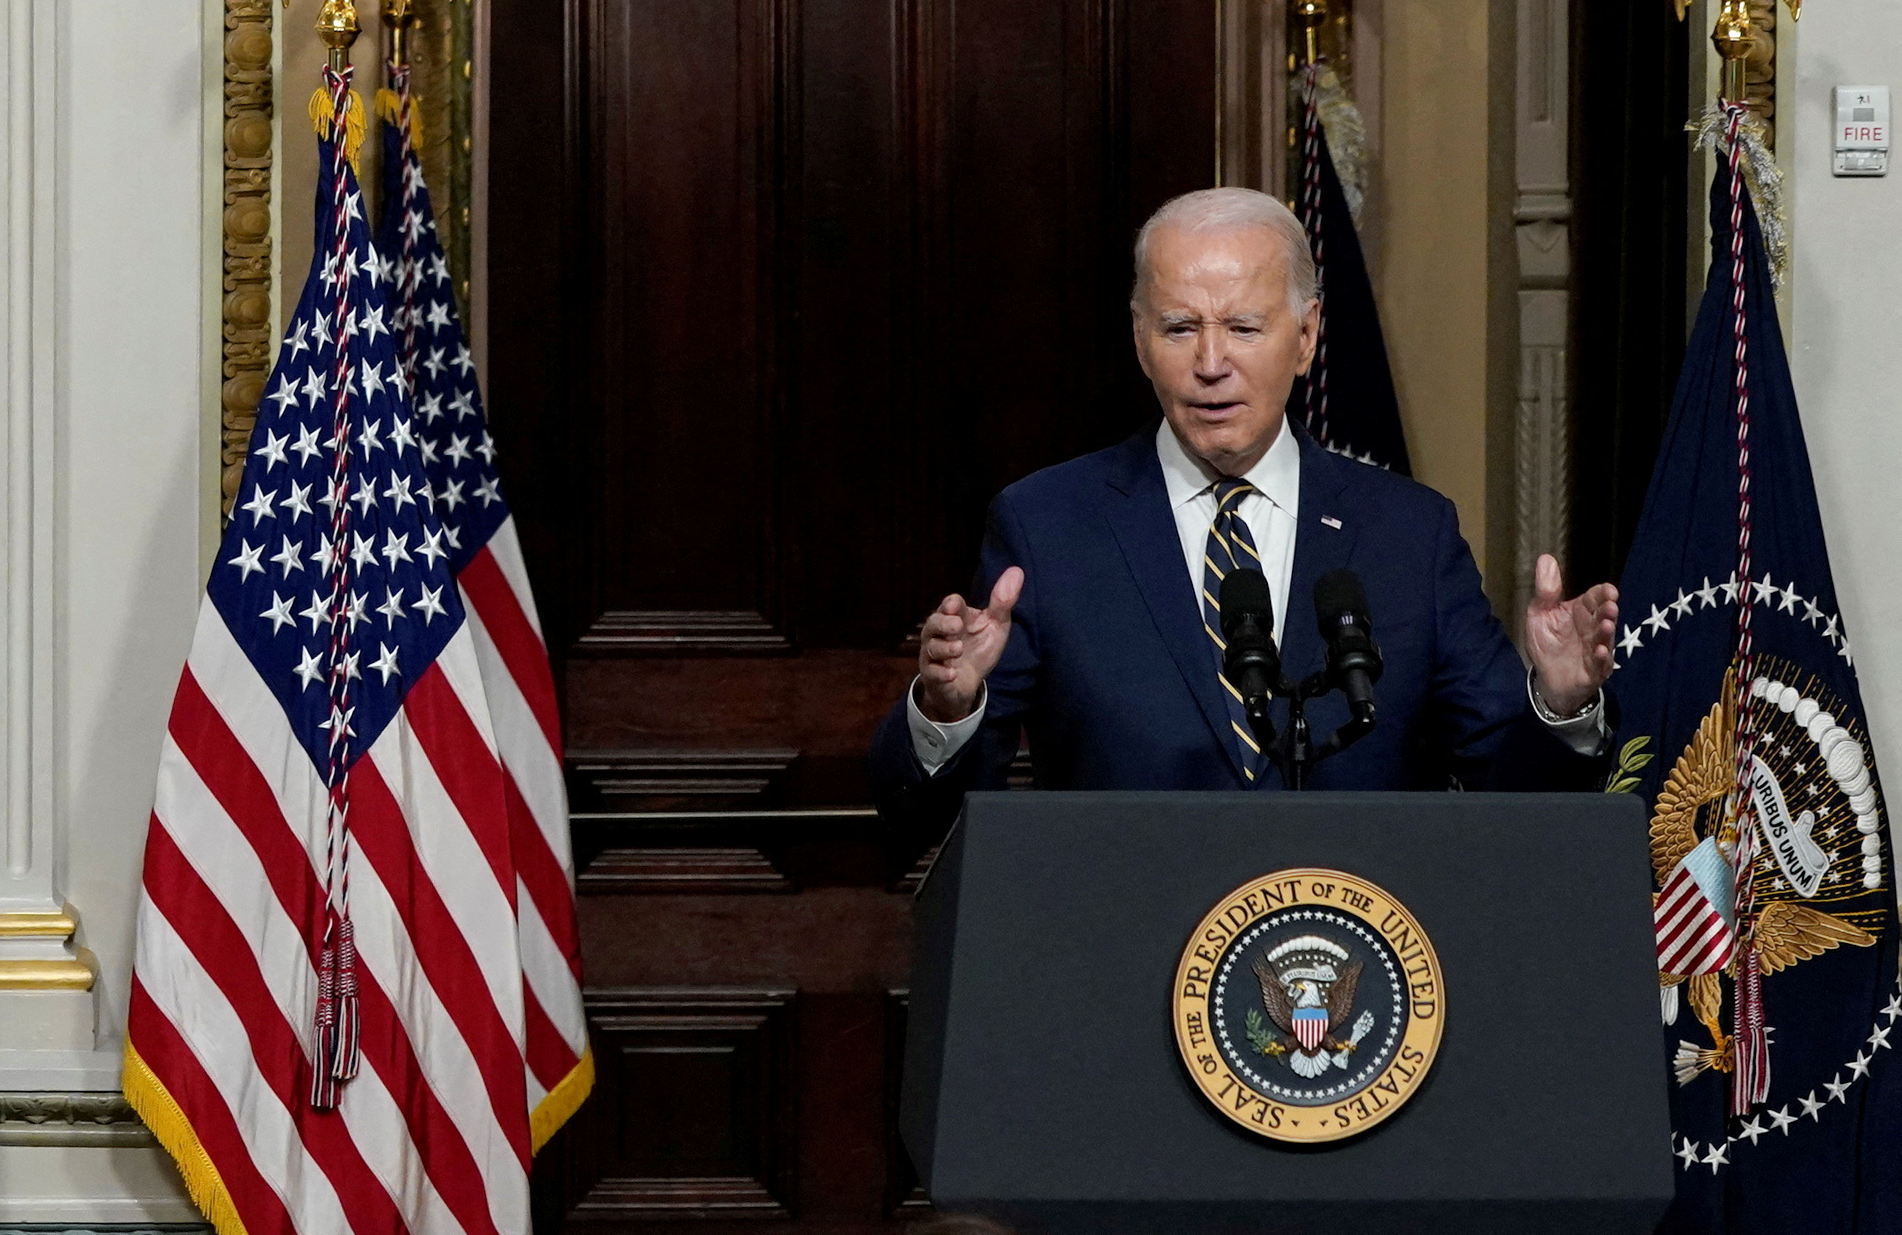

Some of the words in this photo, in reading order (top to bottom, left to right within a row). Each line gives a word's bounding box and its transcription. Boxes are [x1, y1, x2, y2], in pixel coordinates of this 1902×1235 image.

[1844, 127, 1882, 141] FIRE
[1750, 766, 1788, 839] LURIBUS
[1779, 838, 1812, 887] UNUM
[1311, 881, 1336, 900] OF
[1340, 887, 1374, 914] THE
[1183, 879, 1302, 1002] PRESIDENT
[1379, 911, 1436, 1021] UNITED
[1185, 1011, 1206, 1048] THE
[1197, 1053, 1218, 1076] OF
[1334, 1044, 1425, 1130] STATES
[1217, 1073, 1286, 1130] SEAL
